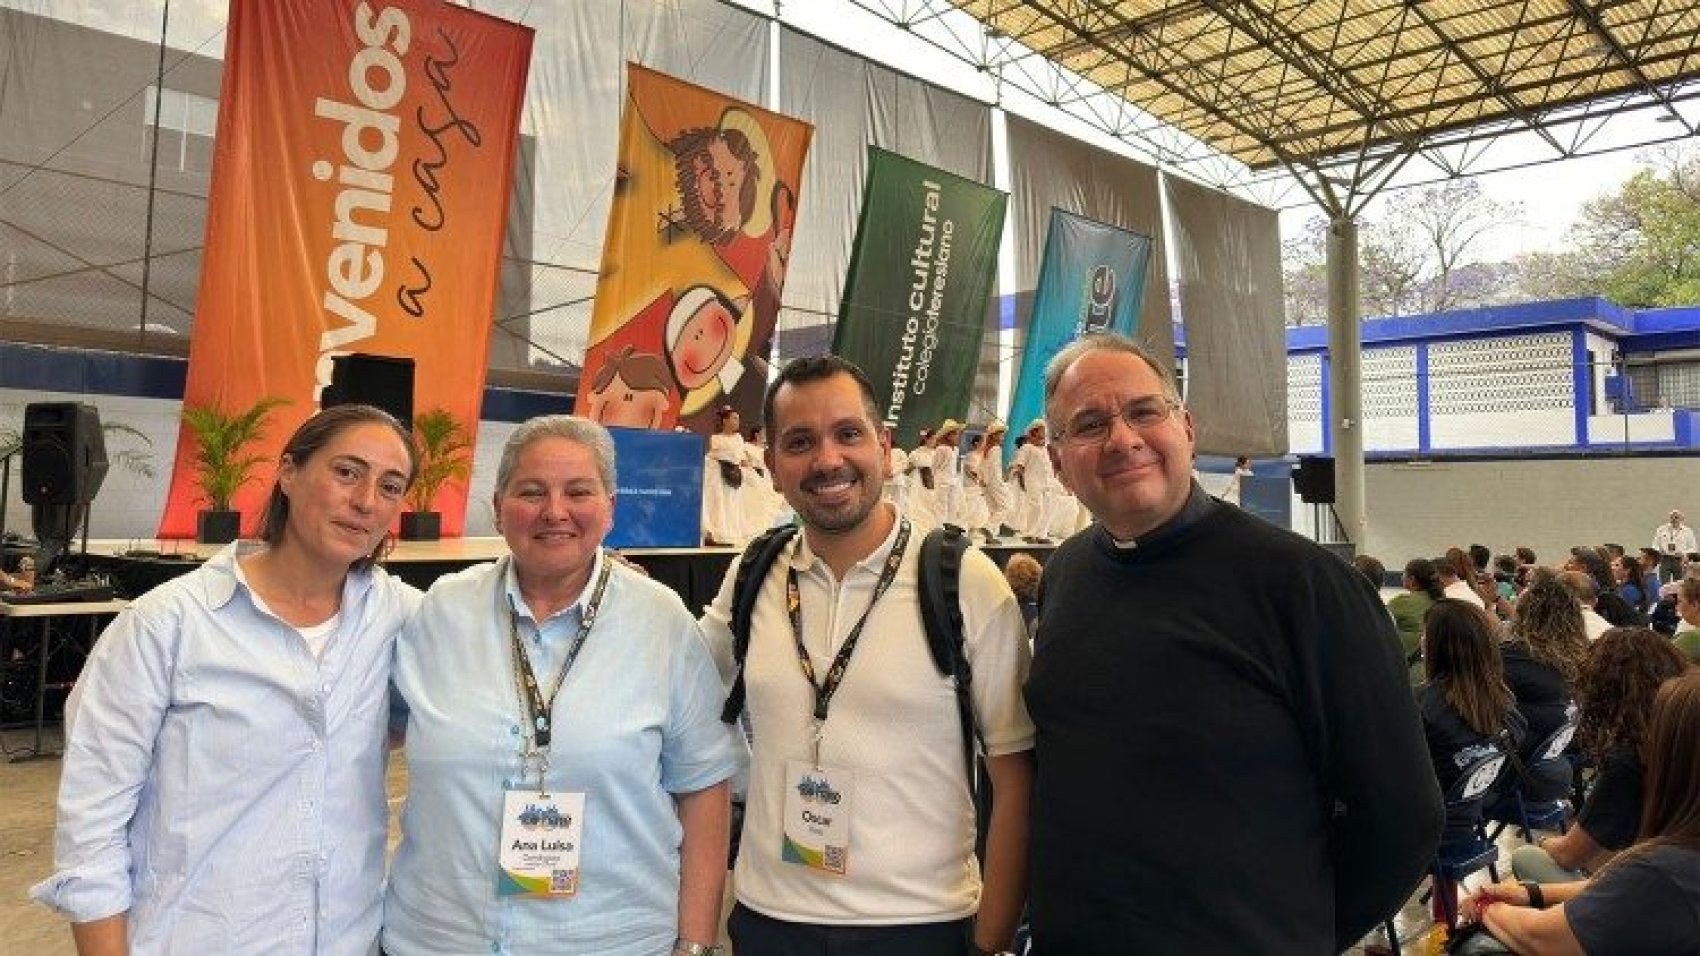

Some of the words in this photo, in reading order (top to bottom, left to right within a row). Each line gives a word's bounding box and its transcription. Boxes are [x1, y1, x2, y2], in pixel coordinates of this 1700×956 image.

[412, 26, 481, 231] casa
[397, 256, 432, 317] a
[909, 179, 941, 311] cultural
[913, 219, 954, 394] colegioteresiano
[512, 839, 538, 850] Ana
[802, 810, 832, 826] Oscar
